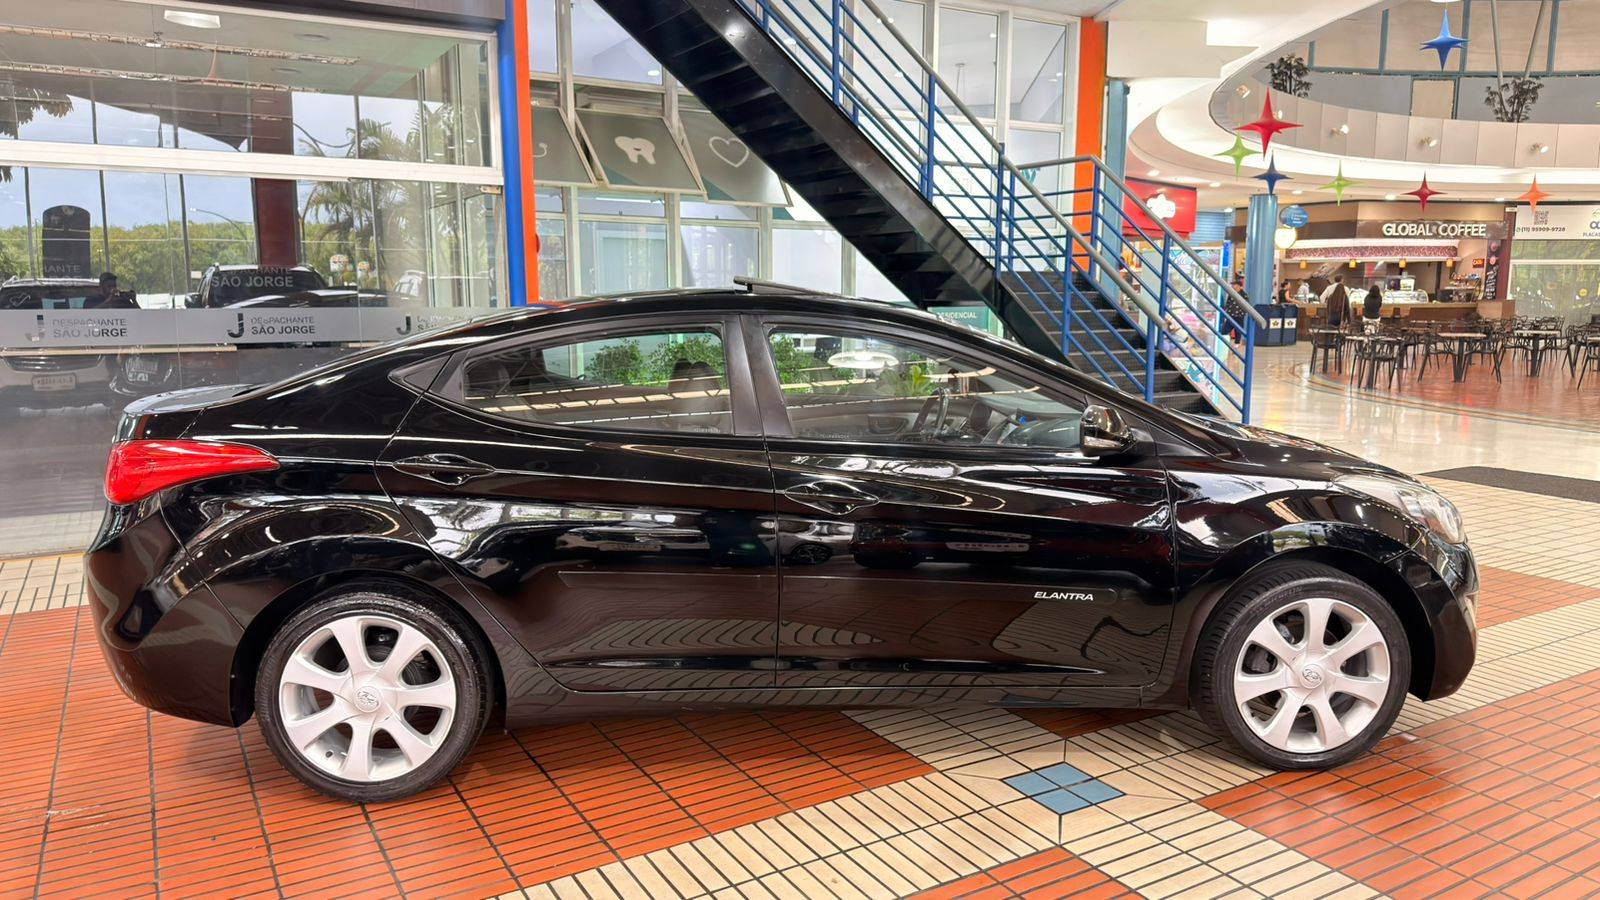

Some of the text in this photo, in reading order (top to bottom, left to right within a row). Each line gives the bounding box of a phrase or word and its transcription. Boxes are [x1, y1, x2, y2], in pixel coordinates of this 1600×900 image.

[1382, 223, 1486, 237] GLOBAL COFFEE
[246, 275, 294, 288] JORGE
[251, 316, 314, 325] DESPACHANTE
[279, 325, 316, 335] JORGE
[1033, 591, 1094, 601] ELANTRA
